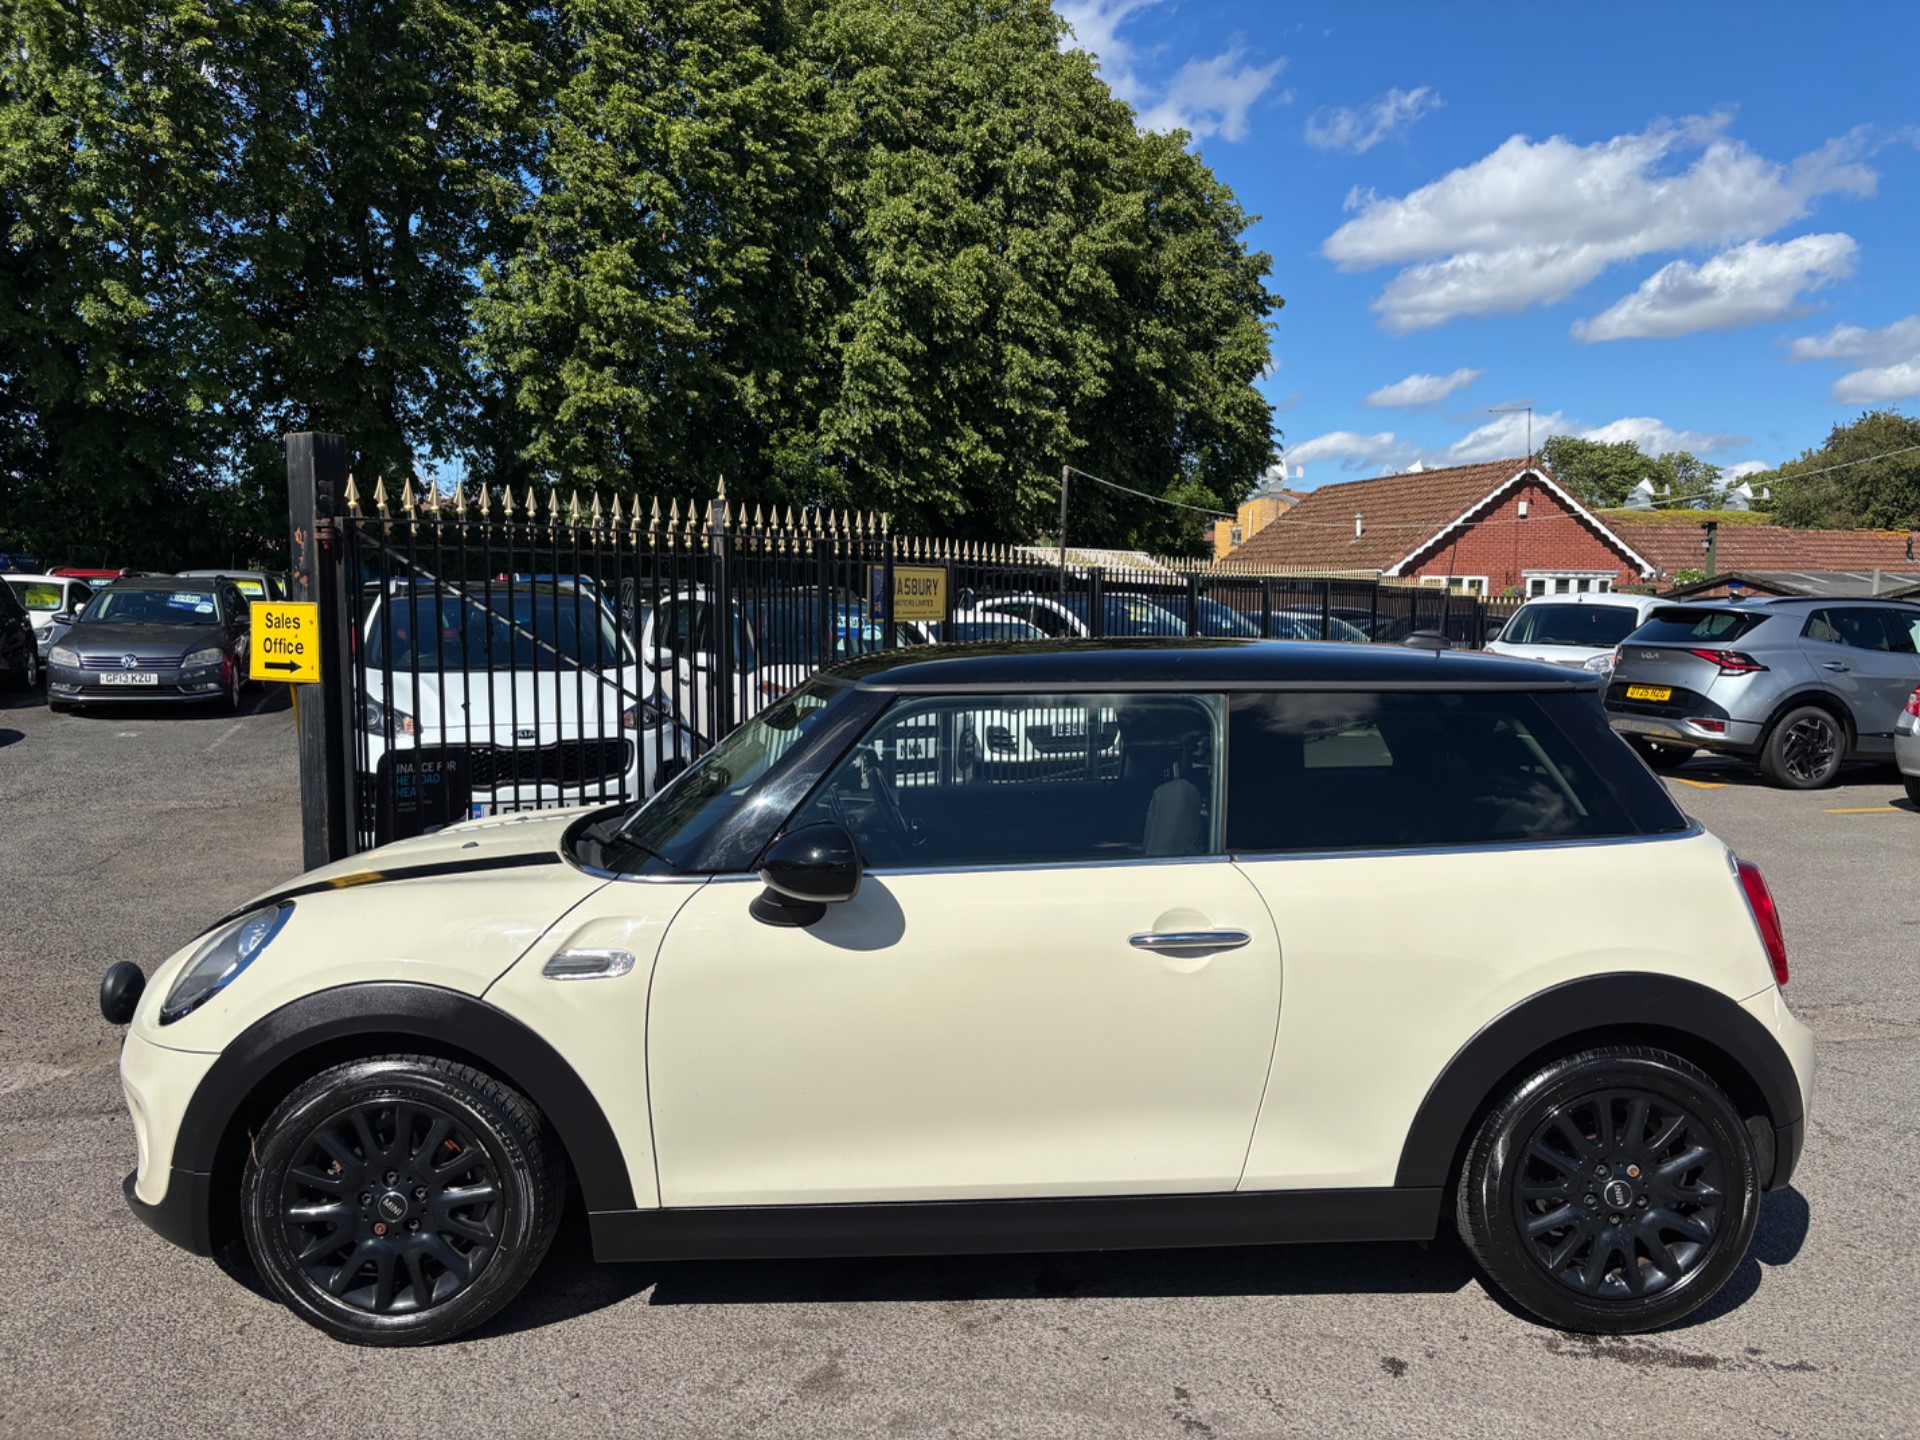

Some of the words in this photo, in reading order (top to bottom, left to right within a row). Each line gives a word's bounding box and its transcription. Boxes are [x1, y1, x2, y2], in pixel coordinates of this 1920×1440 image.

[265, 612, 301, 629] Sales
[263, 637, 304, 655] Office
[105, 673, 129, 684] GF13
[131, 673, 152, 683] KZU
[382, 1198, 403, 1216] MINI
